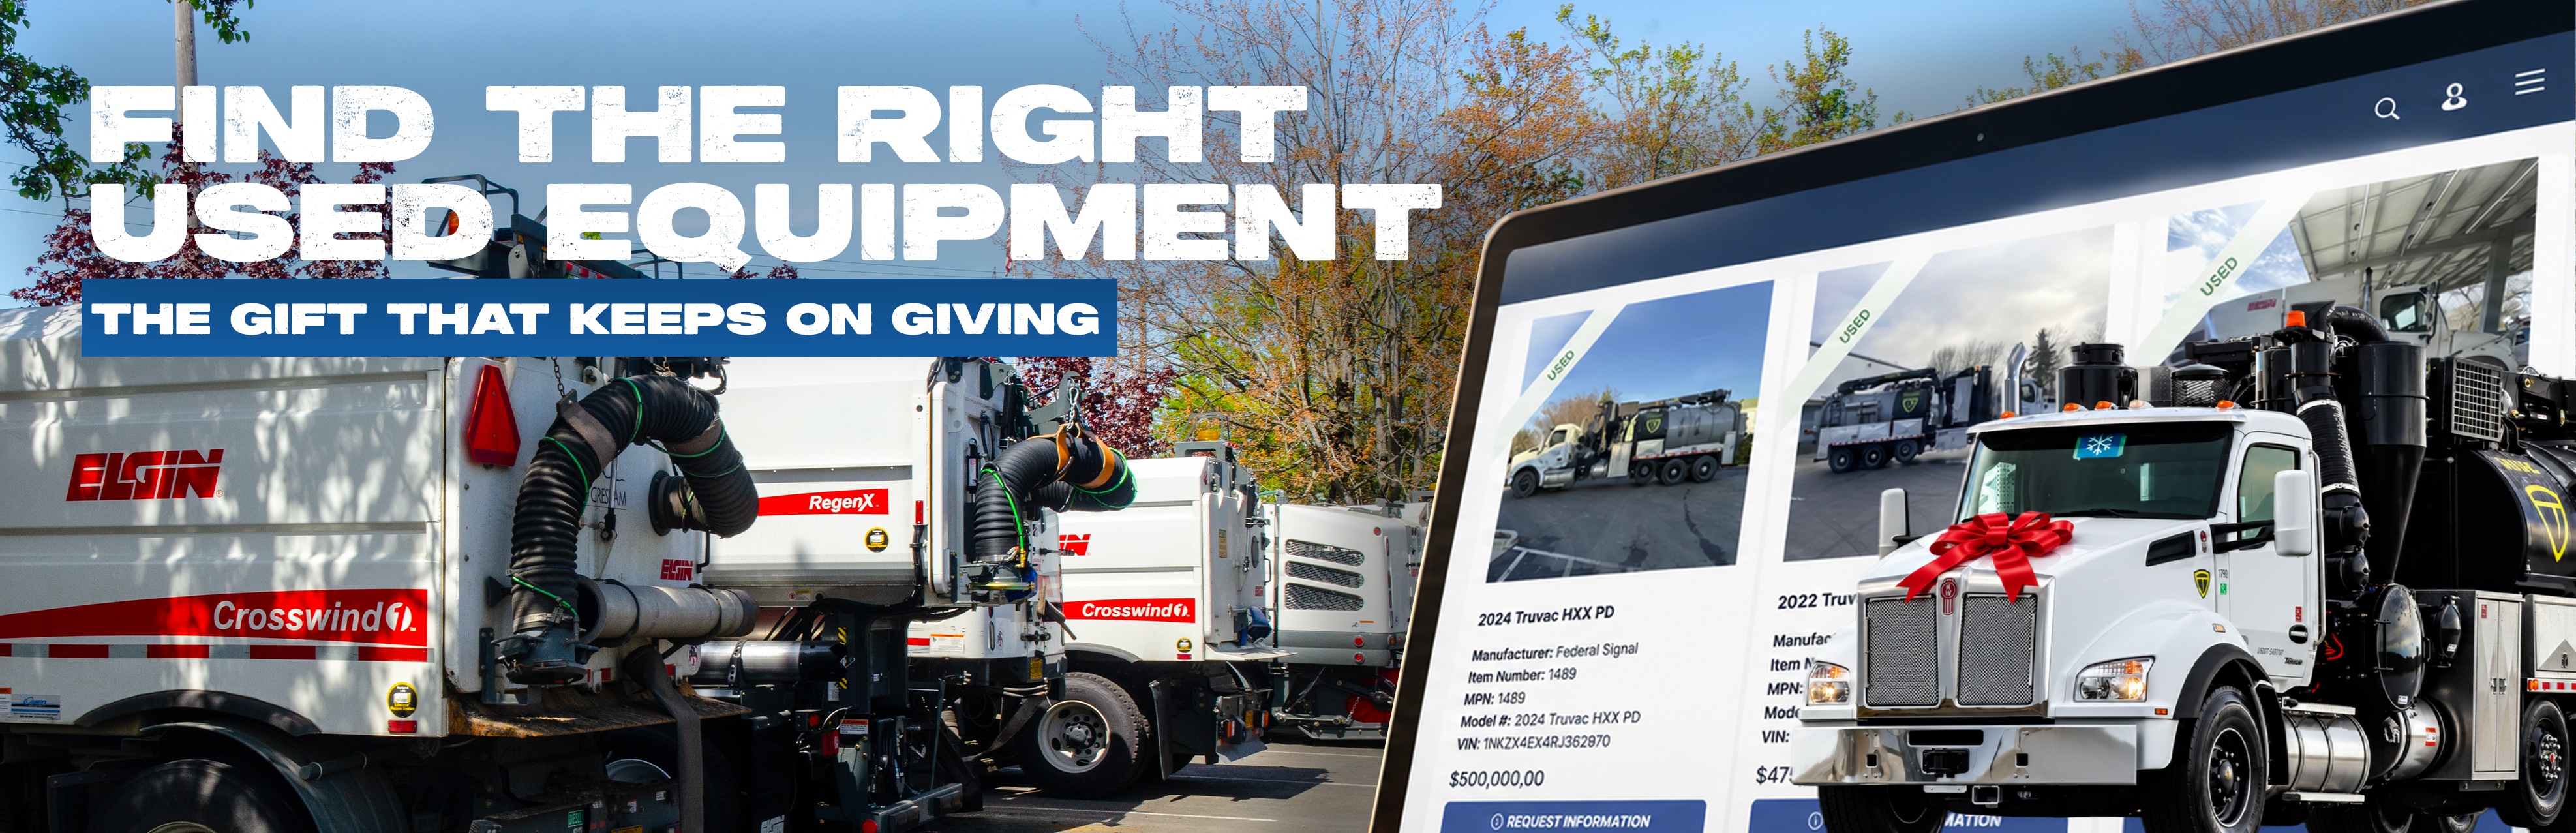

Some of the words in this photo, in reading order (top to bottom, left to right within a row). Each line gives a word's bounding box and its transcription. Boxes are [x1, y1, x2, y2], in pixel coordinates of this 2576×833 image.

[2200, 256, 2238, 296] USED
[1839, 309, 1870, 344] USED
[1547, 350, 1575, 381] USED
[65, 449, 224, 502] ELGIN
[591, 487, 627, 506] GRESAM
[808, 493, 875, 513] RegenX
[660, 558, 693, 581] ELGIN
[1778, 594, 1818, 609] 2022
[1823, 592, 1857, 607] Truv
[1478, 612, 1511, 626] 2024
[1515, 610, 1559, 624] Truvac
[1562, 606, 1593, 621] HXX
[1595, 605, 1615, 618] PD
[1773, 632, 1833, 648] Manufac
[1472, 647, 1553, 662] Manufacturer:
[1556, 644, 1599, 658] Federal
[1602, 642, 1639, 658] Signal
[1770, 658, 1800, 672] Item
[1468, 671, 1493, 684] Item
[1496, 669, 1546, 682] Number:
[1549, 667, 1577, 680] 1489
[1767, 682, 1804, 695] MPN:
[1464, 693, 1494, 706] MPN:
[1498, 691, 1526, 704] 1489
[1460, 714, 1496, 728] Model
[1498, 714, 1511, 727] #:
[1514, 714, 1545, 727] 2024
[1549, 712, 1589, 725] Truvac
[1592, 711, 1620, 725] HXX
[1623, 710, 1641, 724] PD
[1457, 737, 1480, 750] VIN:
[1761, 730, 1790, 743] VIN:
[1449, 770, 1545, 790] $500,000,00
[1506, 815, 1563, 828] REQUEST
[1563, 815, 1651, 828] INFORMATION
[1943, 813, 2003, 828] MATION
